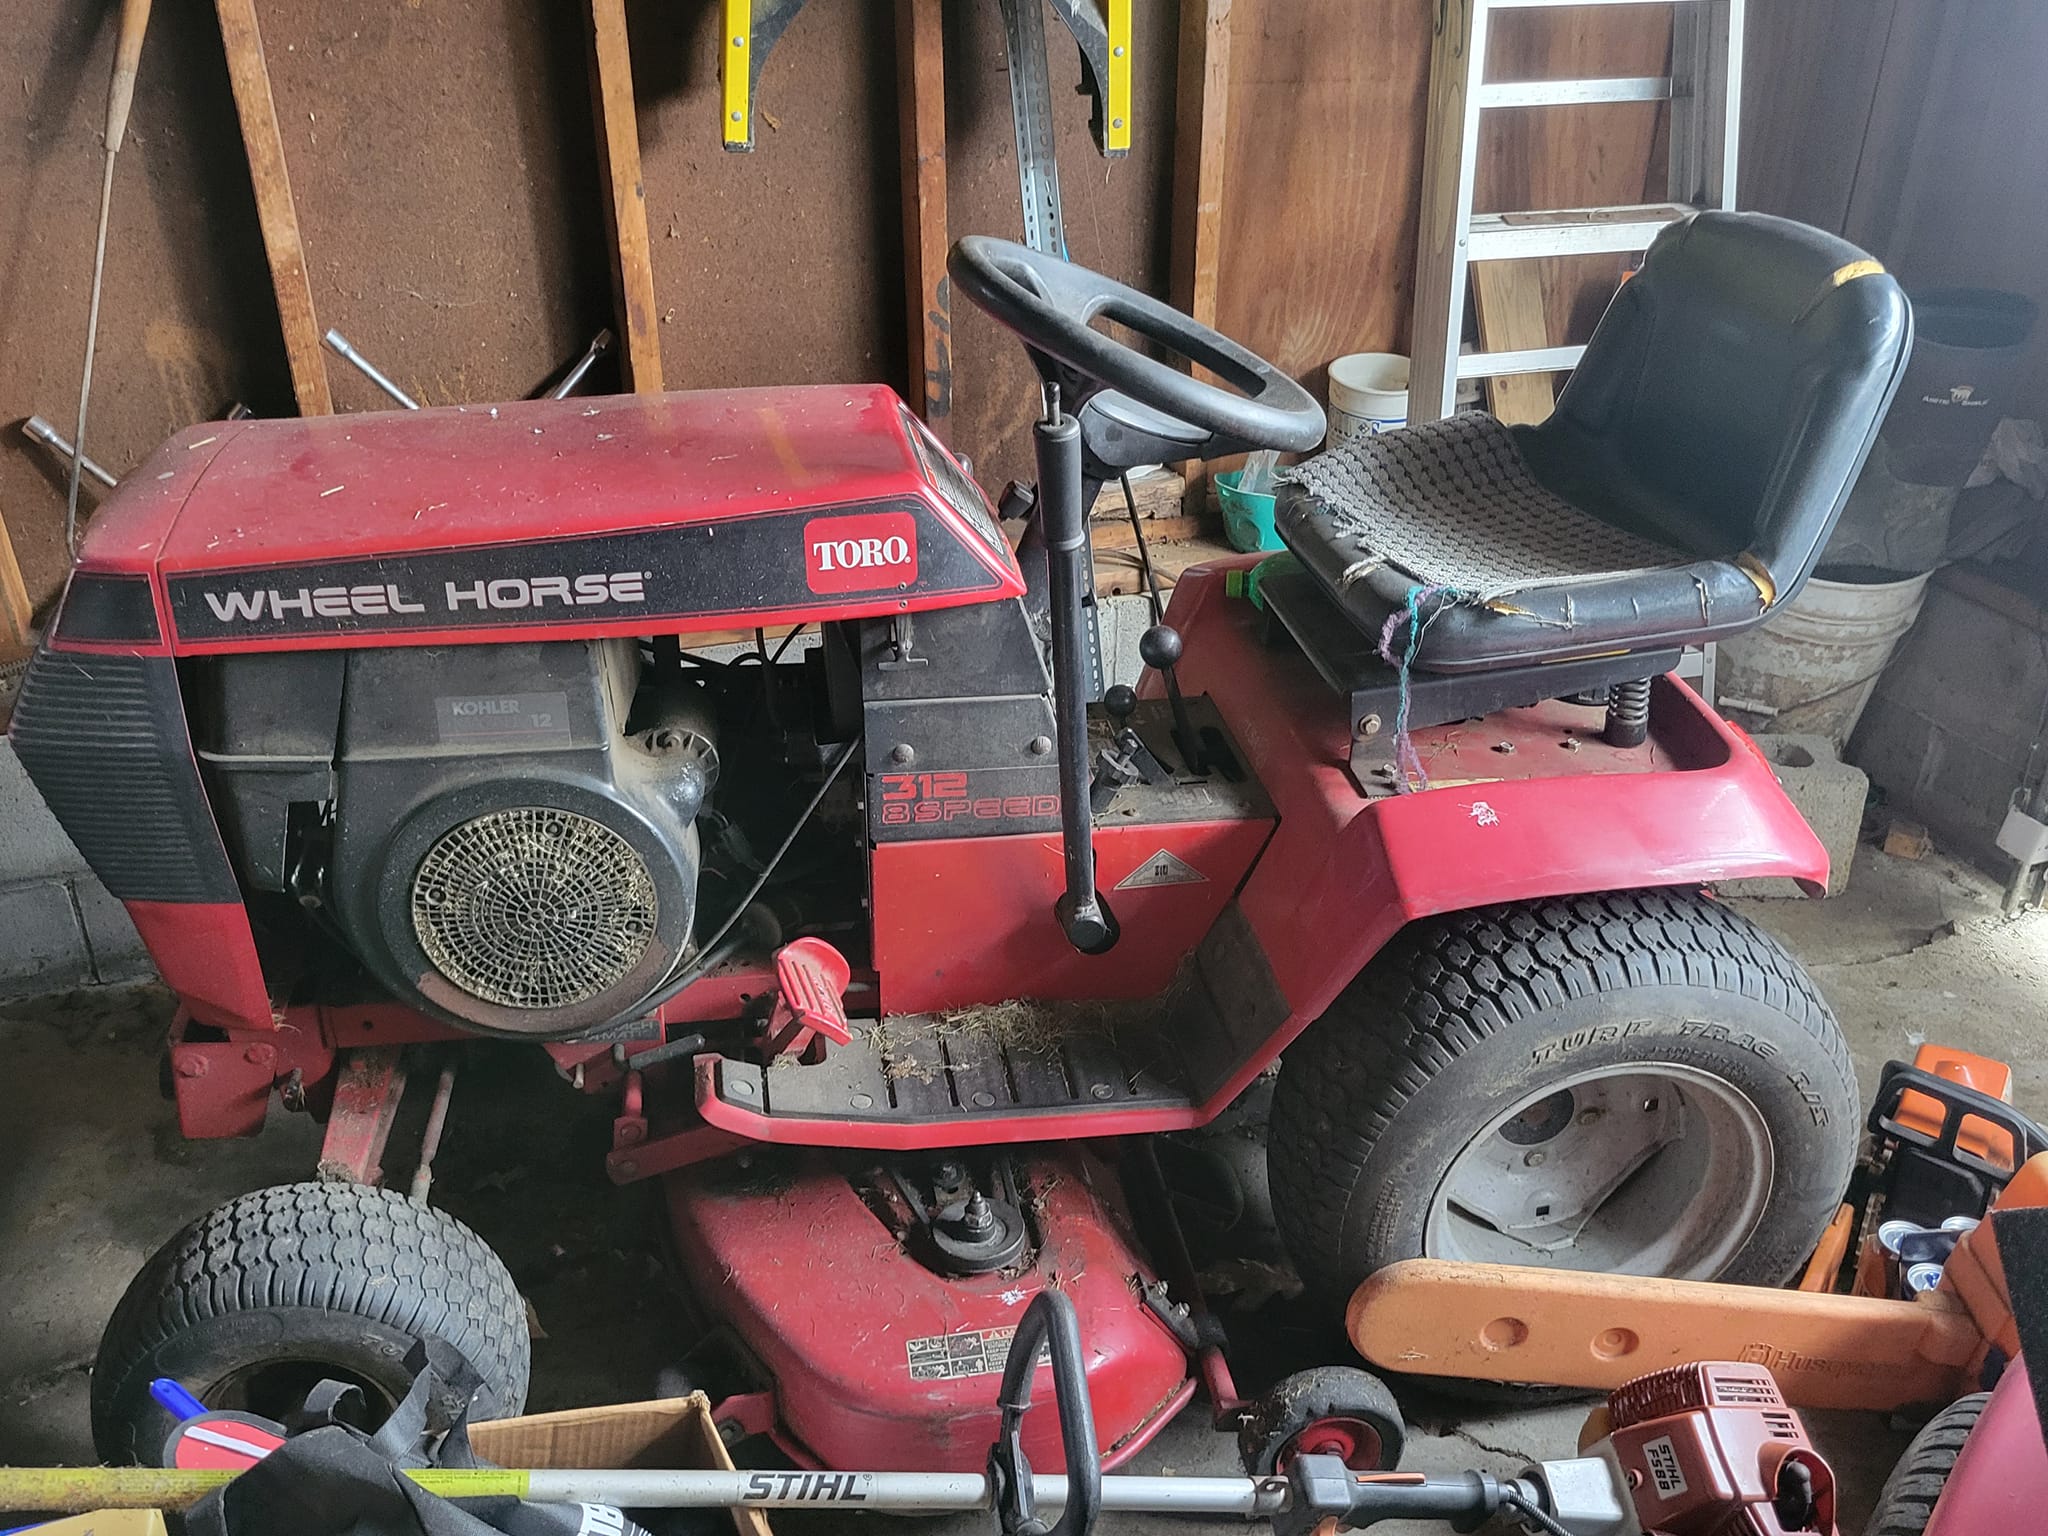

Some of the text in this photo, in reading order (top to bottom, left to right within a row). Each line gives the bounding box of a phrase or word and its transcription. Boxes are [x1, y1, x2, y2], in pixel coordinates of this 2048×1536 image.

[813, 535, 912, 571] TORO
[203, 570, 652, 622] WHEEL HORSE
[451, 699, 521, 716] KOHLER
[530, 713, 553, 728] 12
[881, 772, 968, 801] 312
[1531, 1020, 1653, 1065] TURF
[1678, 1017, 1779, 1061] TRAC
[1658, 1443, 1682, 1490] STIHL
[742, 1472, 872, 1501] STIHL
